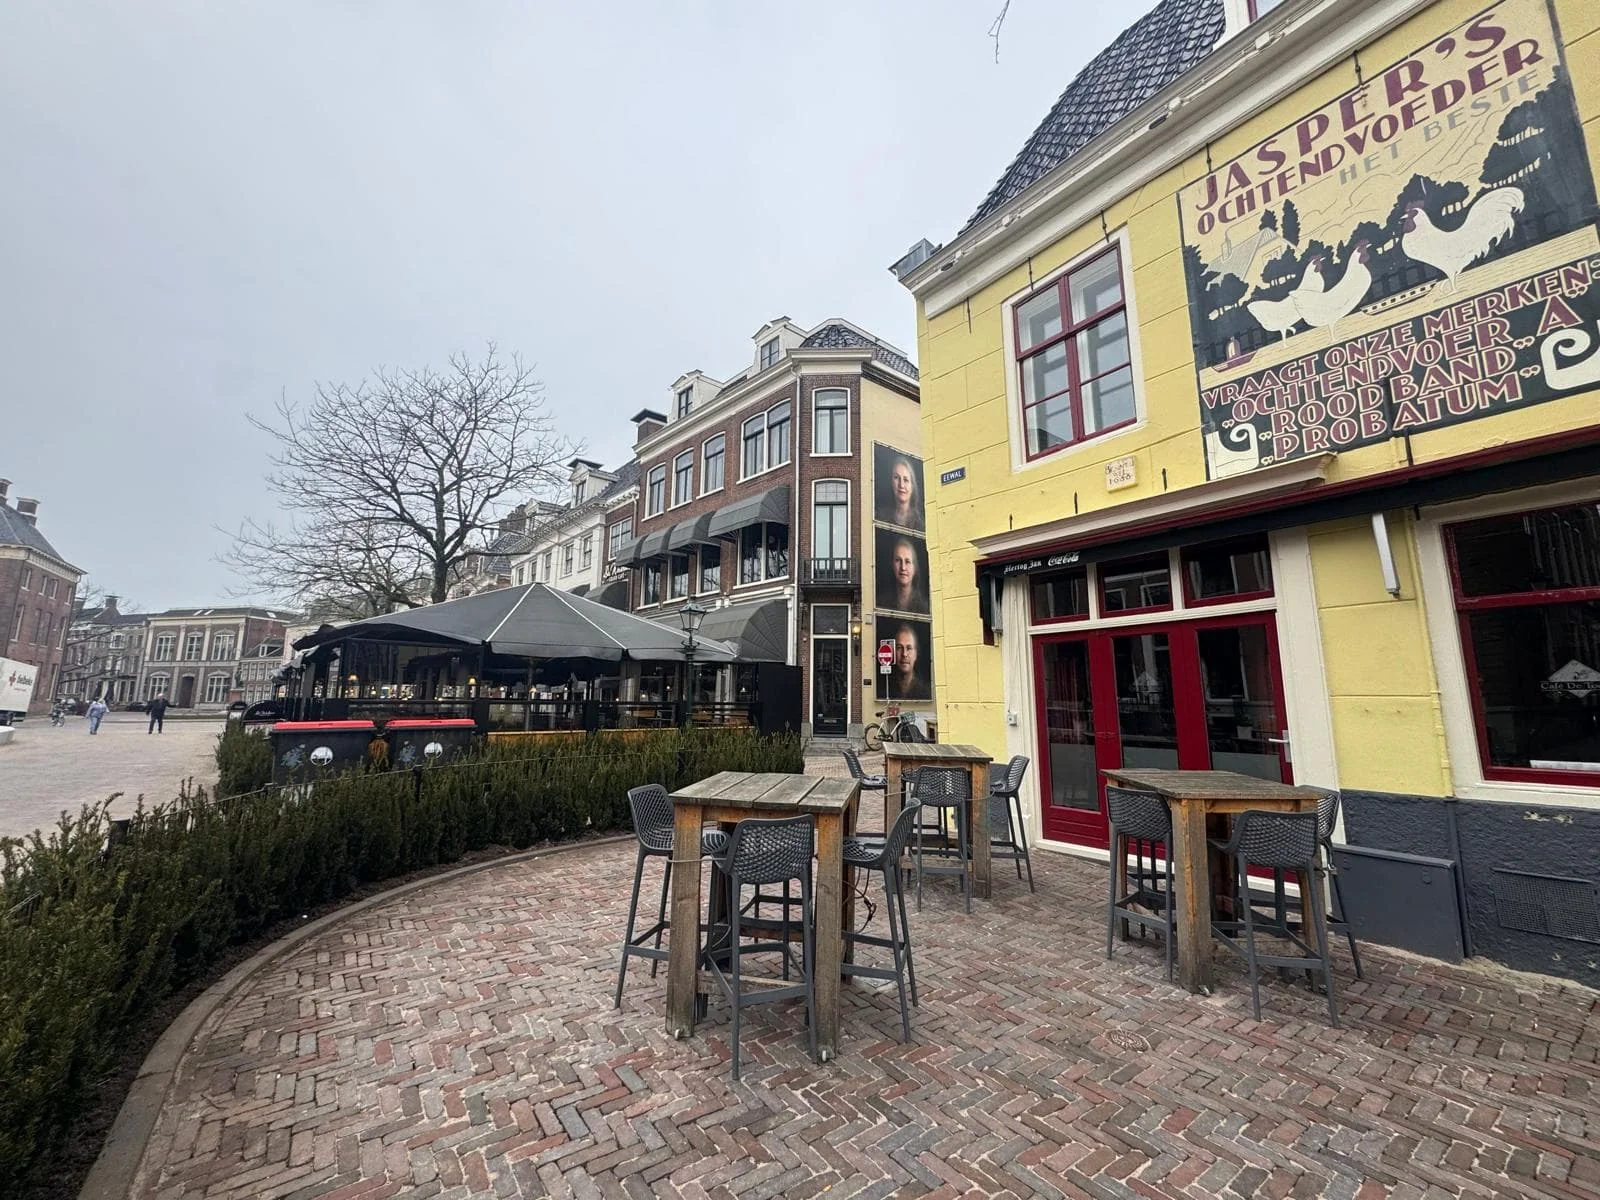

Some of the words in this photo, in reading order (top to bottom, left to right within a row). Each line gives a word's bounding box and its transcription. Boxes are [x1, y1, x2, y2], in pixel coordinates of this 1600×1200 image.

[1196, 14, 1506, 211] JASPER'S
[1197, 38, 1545, 235] OCHTENDVOEDER
[1339, 138, 1403, 185] HET
[1423, 69, 1541, 142] BESTE
[1201, 354, 1319, 409] VRAAGT
[1324, 321, 1416, 369] ONZE
[942, 469, 963, 482] EEWAL
[1567, 682, 1583, 690] De
